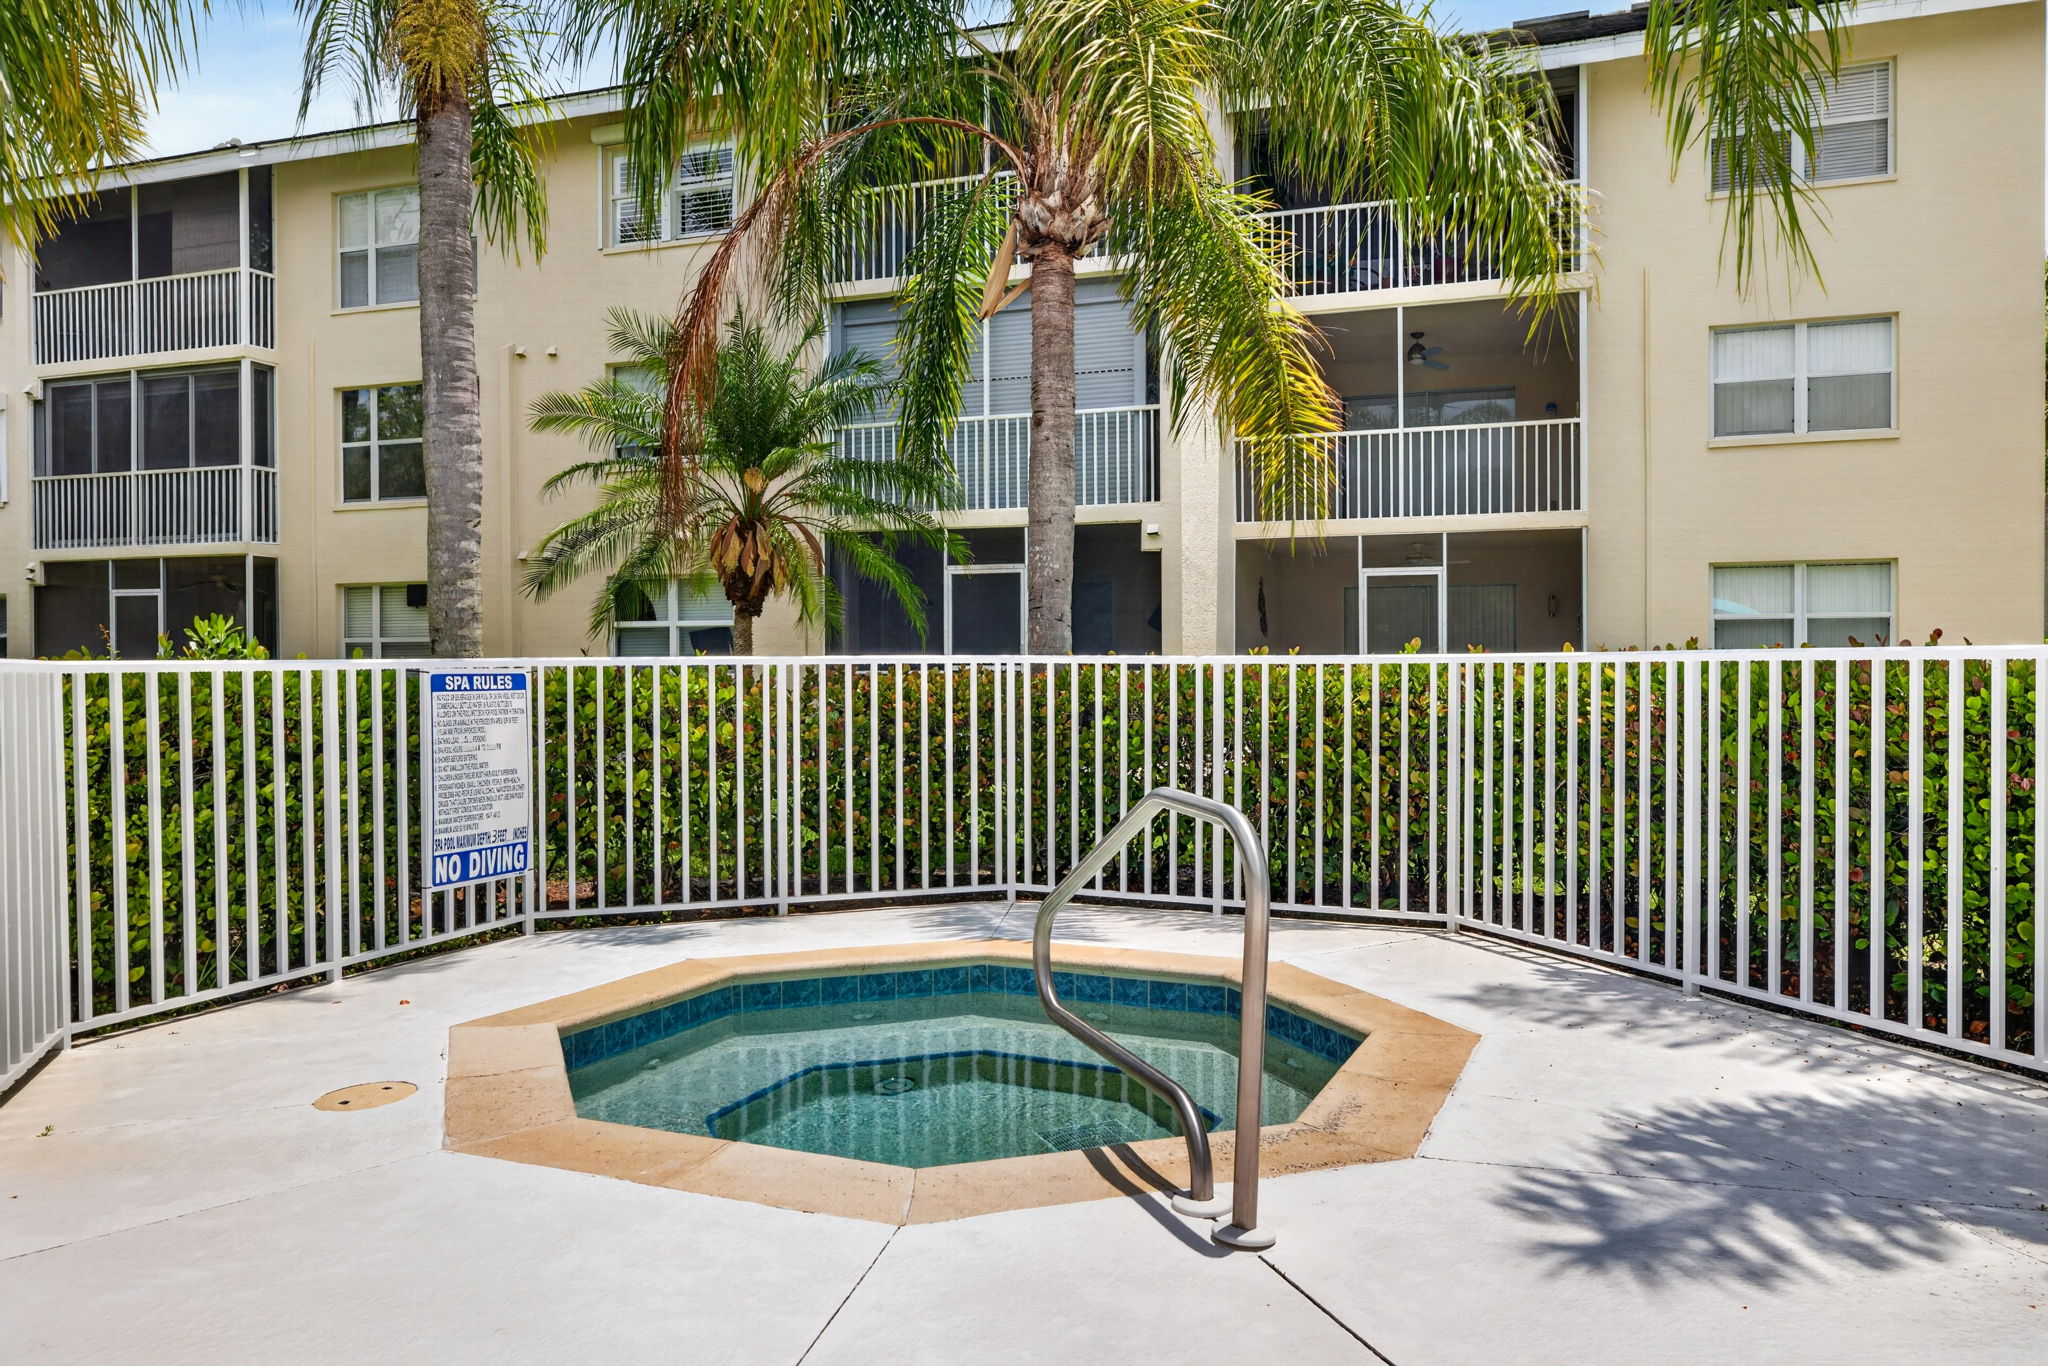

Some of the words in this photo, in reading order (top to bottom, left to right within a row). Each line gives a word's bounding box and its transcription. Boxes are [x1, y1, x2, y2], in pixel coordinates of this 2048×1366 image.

[445, 675, 470, 690] SPA
[473, 675, 512, 690] RULES
[435, 838, 443, 852] SPA
[444, 836, 455, 850] POOL
[492, 829, 497, 844] 3
[498, 828, 507, 842] FEET
[513, 826, 527, 840] INCHES
[436, 854, 461, 884] NO
[469, 844, 525, 878] DIVING
